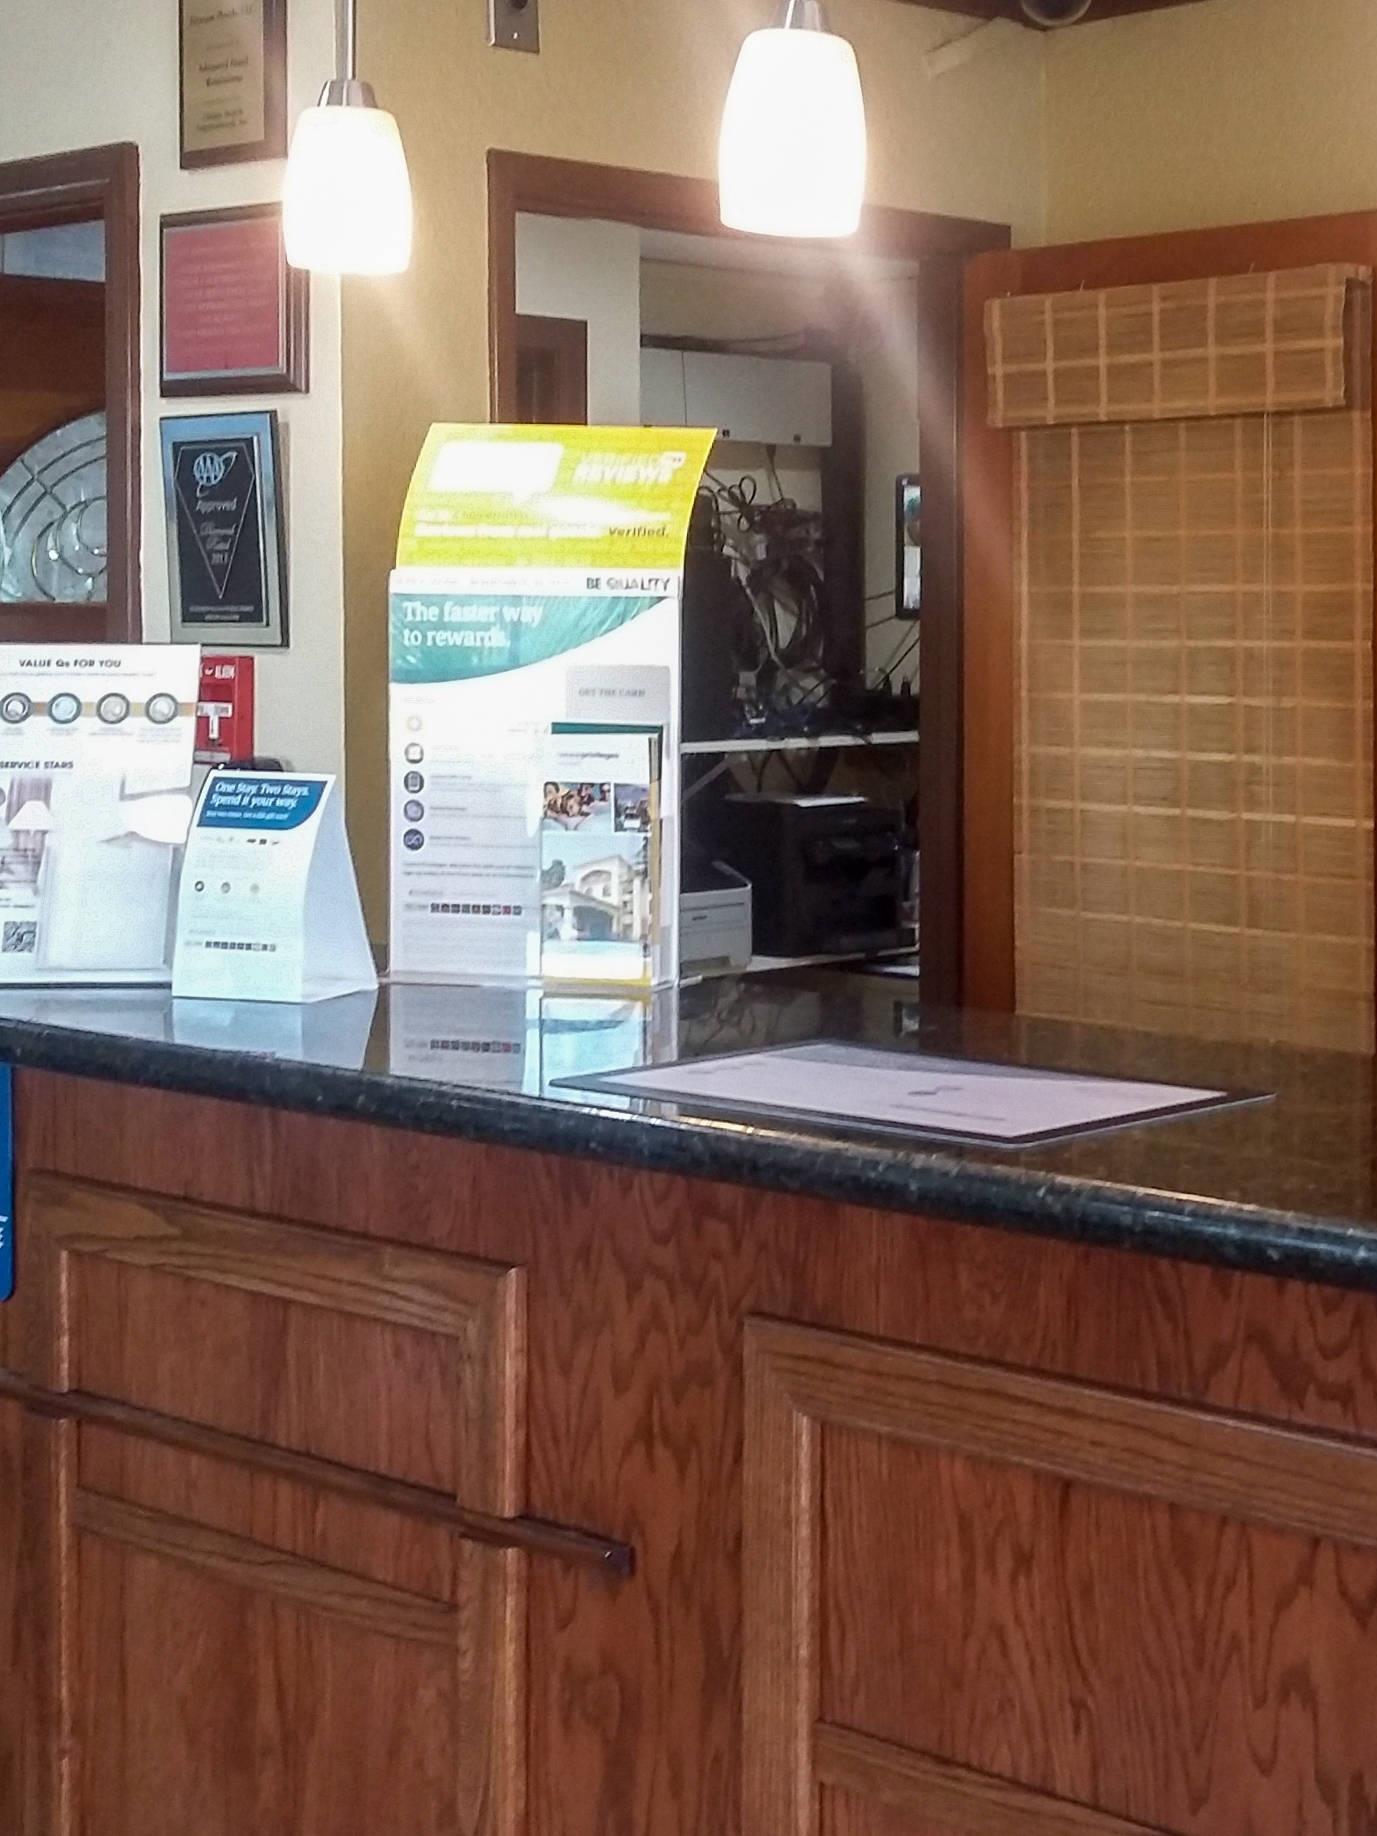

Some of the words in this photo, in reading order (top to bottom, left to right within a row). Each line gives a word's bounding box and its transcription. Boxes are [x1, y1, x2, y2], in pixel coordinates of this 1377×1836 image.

[586, 577, 601, 590] BE
[606, 576, 670, 591] QUALITY
[402, 601, 440, 622] The
[443, 600, 500, 622] faster
[502, 605, 544, 628] way
[402, 628, 423, 647] to
[19, 659, 51, 668] VALUE
[73, 659, 96, 668] FOR
[98, 659, 122, 668] YOU
[43, 760, 74, 769] STARS
[214, 781, 236, 793] One
[260, 783, 282, 795] Two
[210, 792, 241, 808] Spend
[249, 796, 275, 809] your
